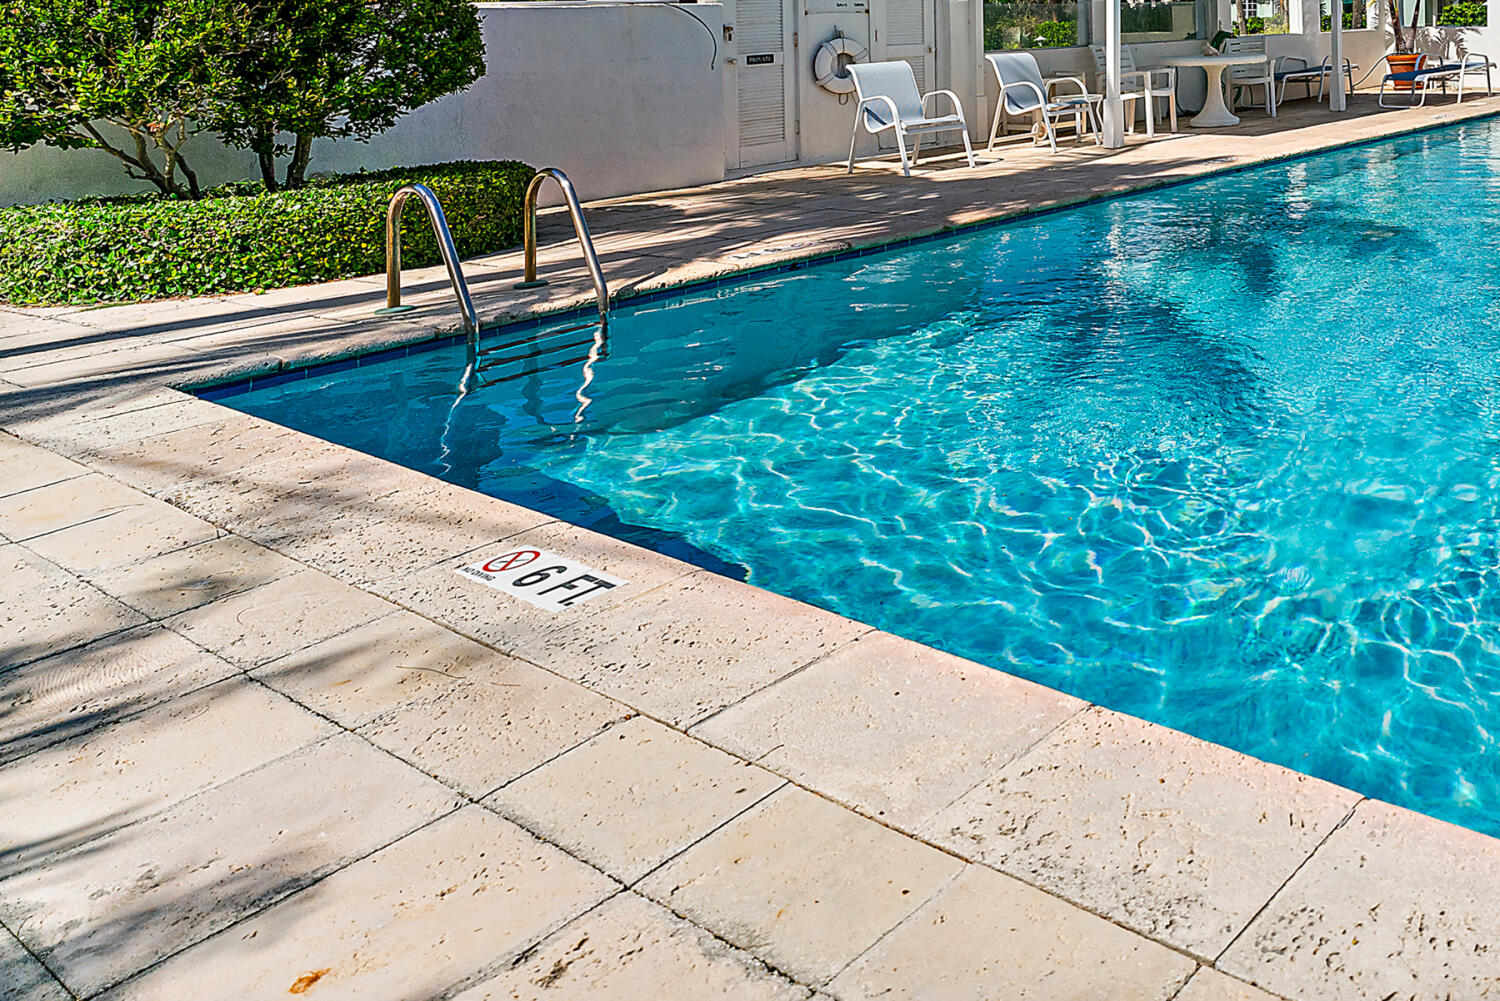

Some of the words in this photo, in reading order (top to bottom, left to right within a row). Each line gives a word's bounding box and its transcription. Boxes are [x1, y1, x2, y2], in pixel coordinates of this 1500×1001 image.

[748, 55, 772, 63] PRIVATE
[461, 566, 475, 576] NO
[470, 569, 497, 582] DIVING
[512, 565, 567, 587] 6
